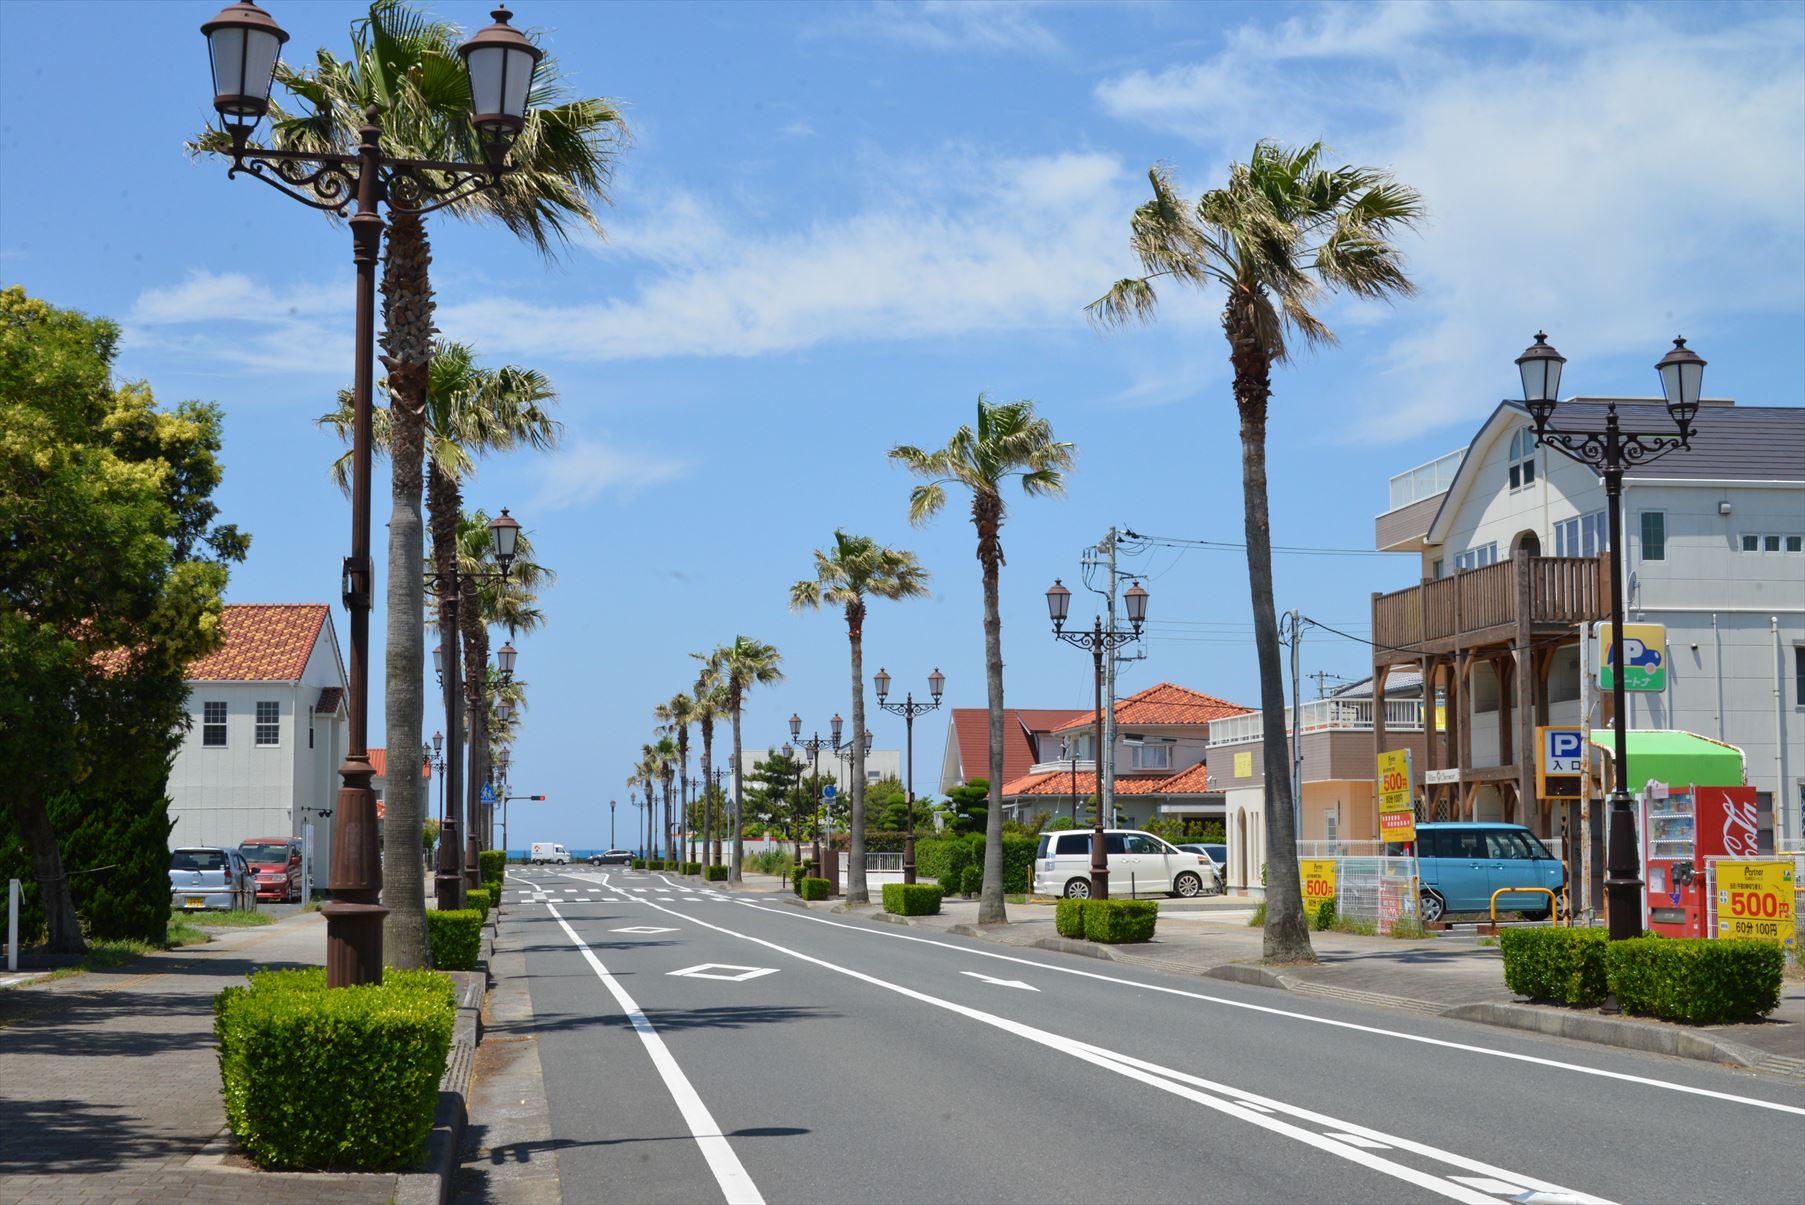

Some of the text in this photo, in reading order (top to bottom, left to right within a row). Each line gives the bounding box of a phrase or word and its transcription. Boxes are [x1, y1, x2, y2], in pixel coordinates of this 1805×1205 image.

[1555, 734, 1578, 756] P
[1553, 760, 1581, 771] 入口
[1383, 772, 1407, 792] 500円
[1307, 880, 1333, 896] 500円
[1731, 892, 1790, 918] 500円
[1736, 921, 1778, 936] 60分 100円
